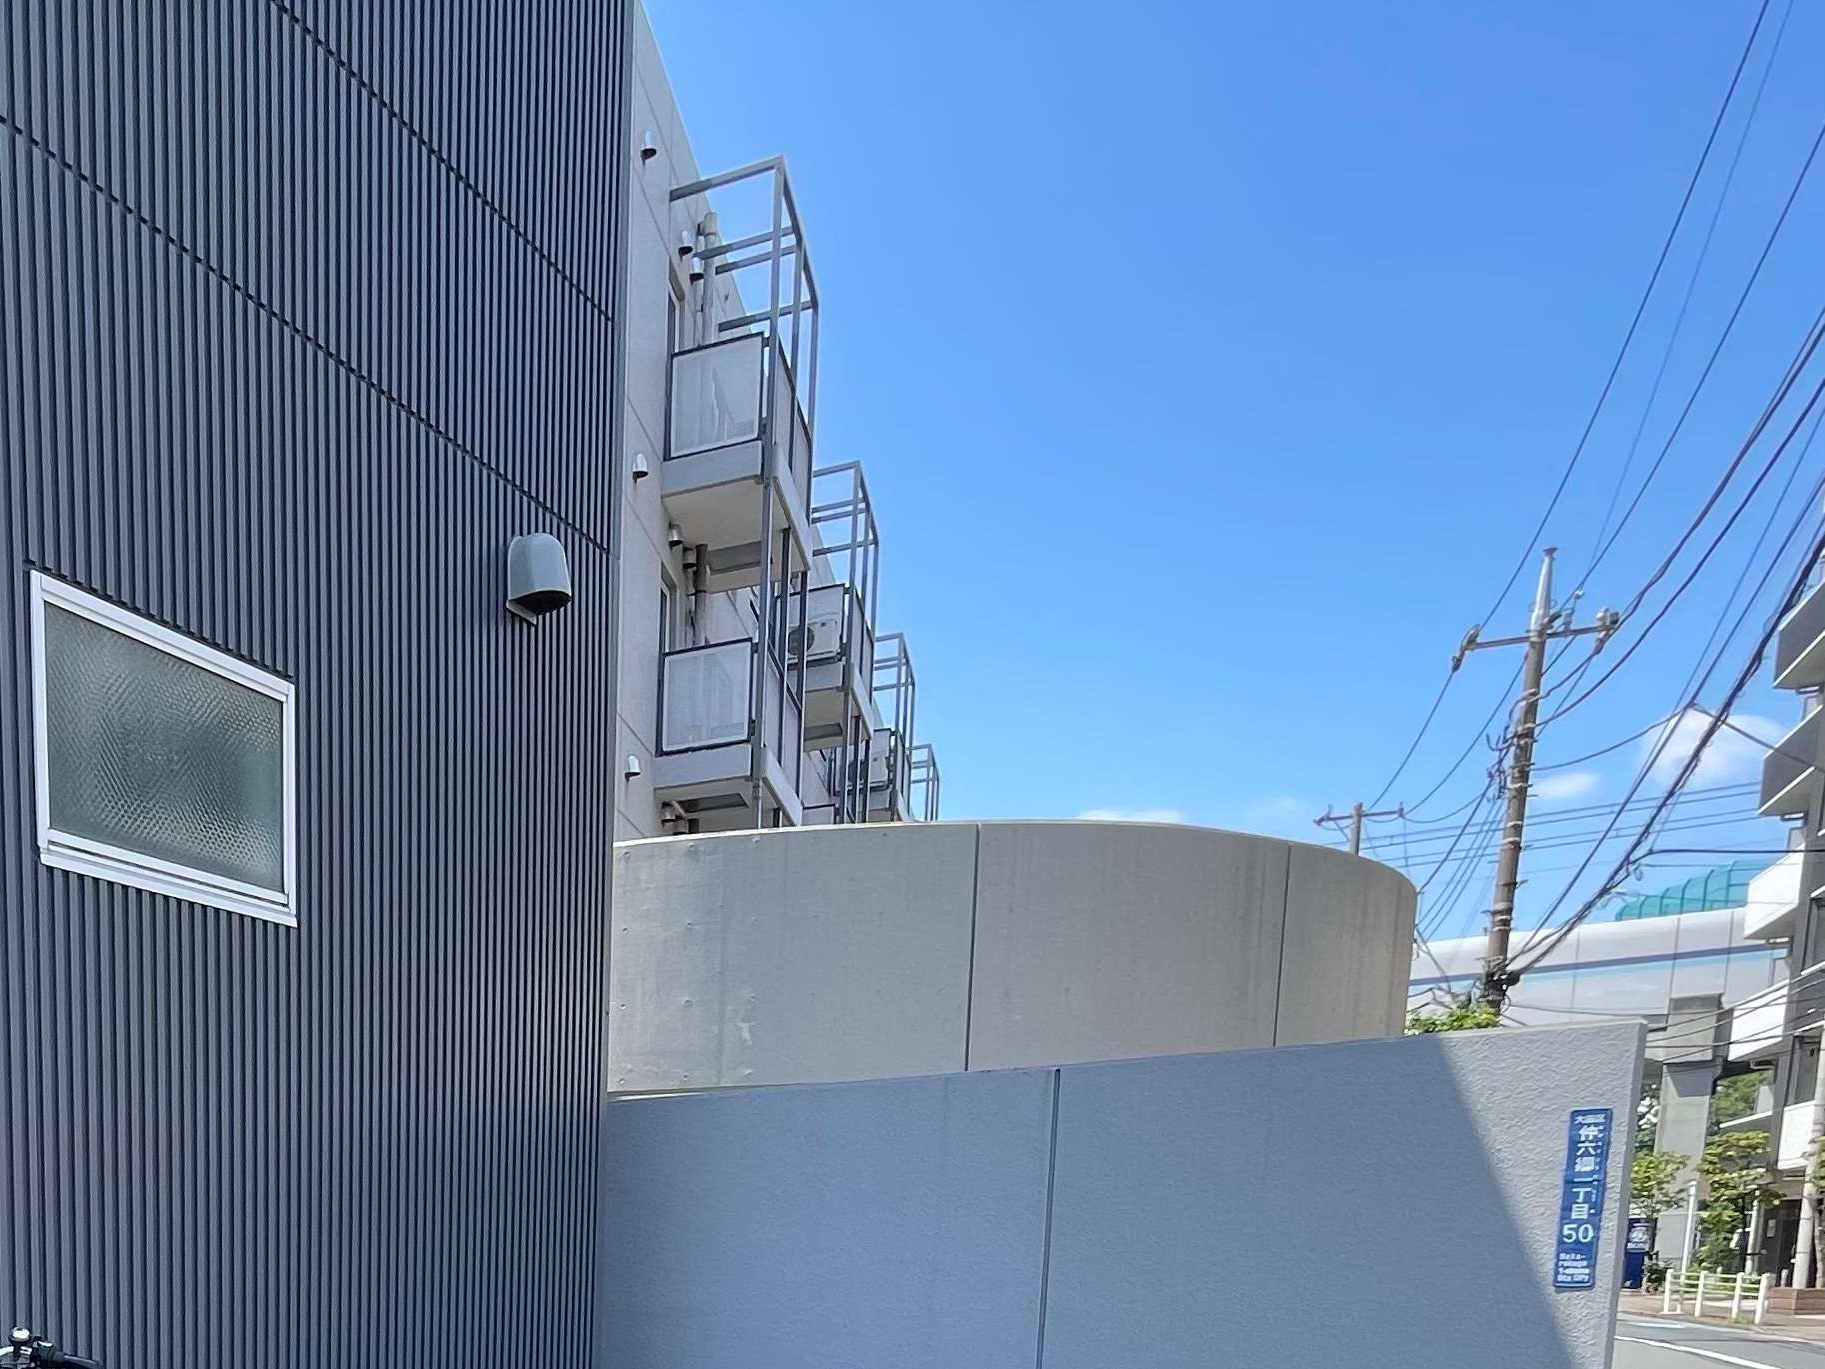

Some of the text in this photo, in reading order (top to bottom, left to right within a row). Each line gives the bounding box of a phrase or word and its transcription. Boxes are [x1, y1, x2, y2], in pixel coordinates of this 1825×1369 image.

[1571, 1125, 1599, 1219] 仲六郷一丁目
[1562, 1223, 1594, 1243] 50
